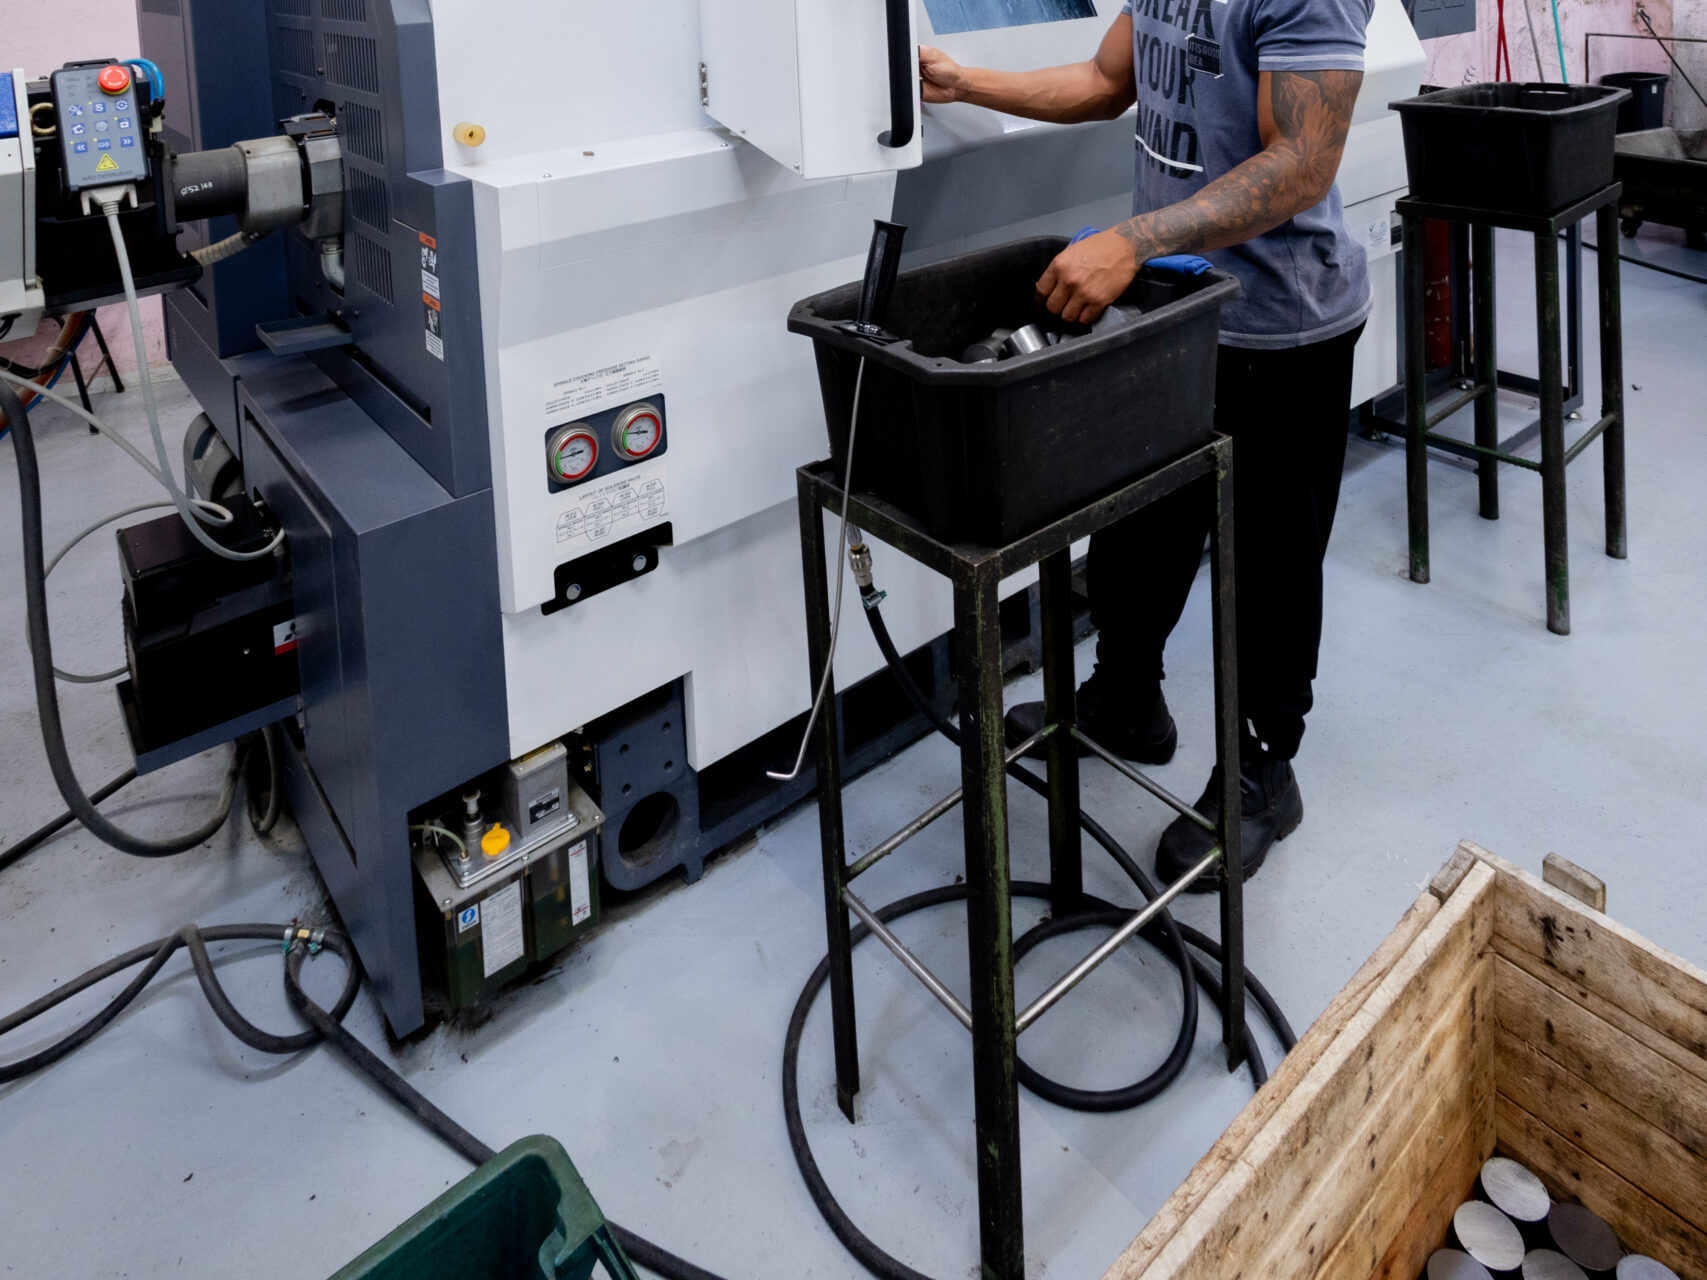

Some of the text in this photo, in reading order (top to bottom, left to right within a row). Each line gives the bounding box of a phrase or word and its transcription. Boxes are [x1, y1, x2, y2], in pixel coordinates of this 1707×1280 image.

[1136, 30, 1196, 109] YOUR
[1188, 54, 1203, 67] IDEA
[1195, 43, 1202, 55] IS
[1134, 99, 1199, 179] MIND
